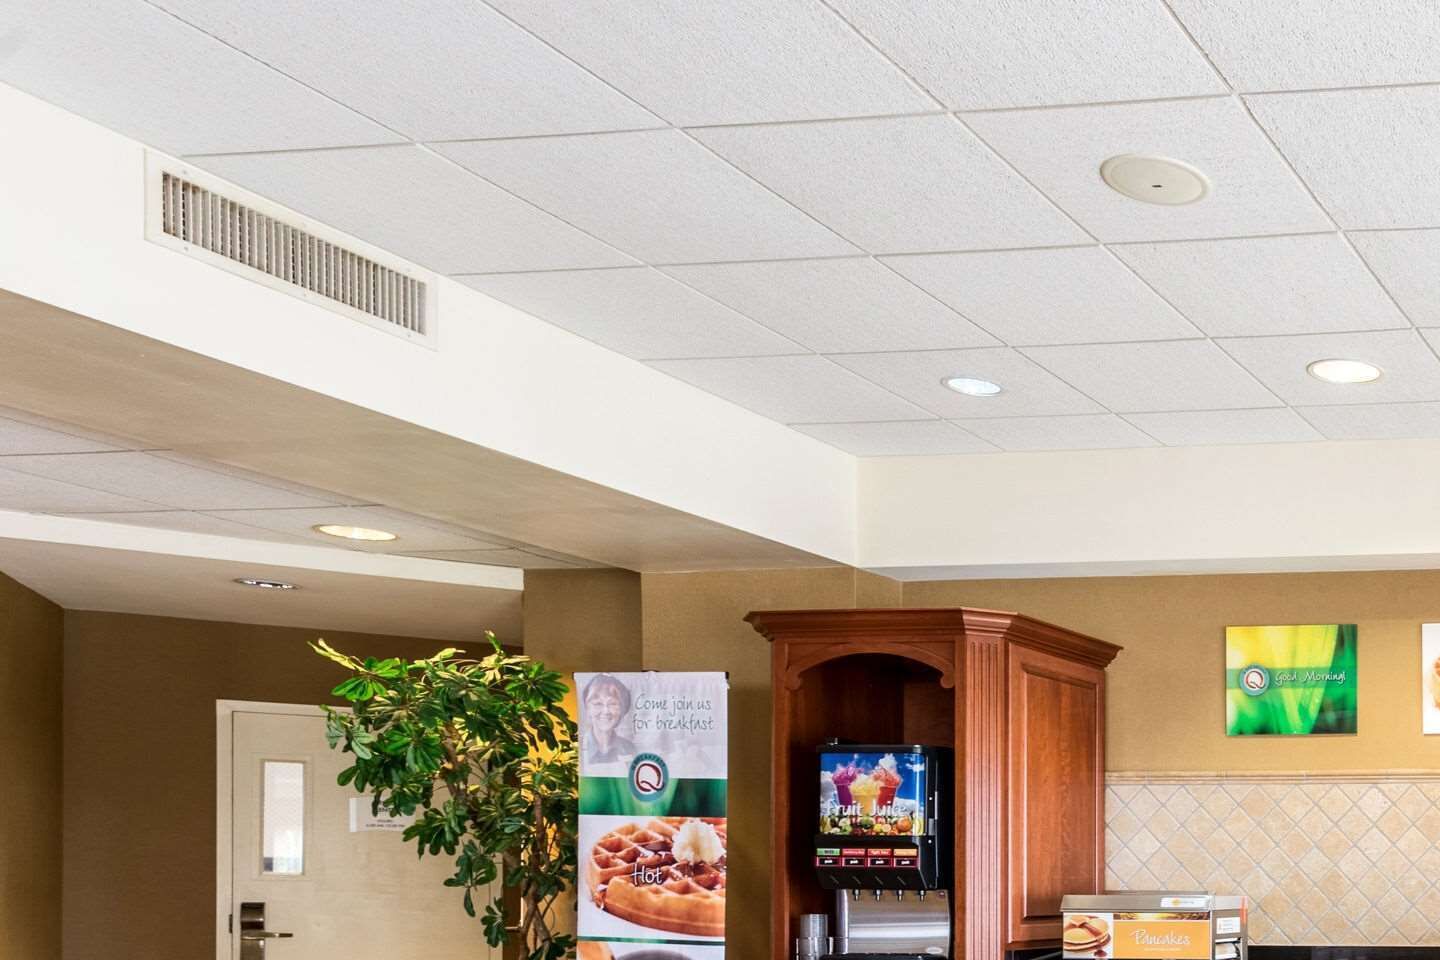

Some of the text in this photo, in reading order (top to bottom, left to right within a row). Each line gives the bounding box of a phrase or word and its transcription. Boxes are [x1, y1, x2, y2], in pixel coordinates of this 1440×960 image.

[1275, 671, 1297, 687] Good
[634, 693, 712, 717] Come join us
[632, 713, 714, 735] for breakfast
[826, 799, 909, 816] Fruit Juice
[631, 862, 663, 886] Hot
[1130, 928, 1191, 945] Pancakes
